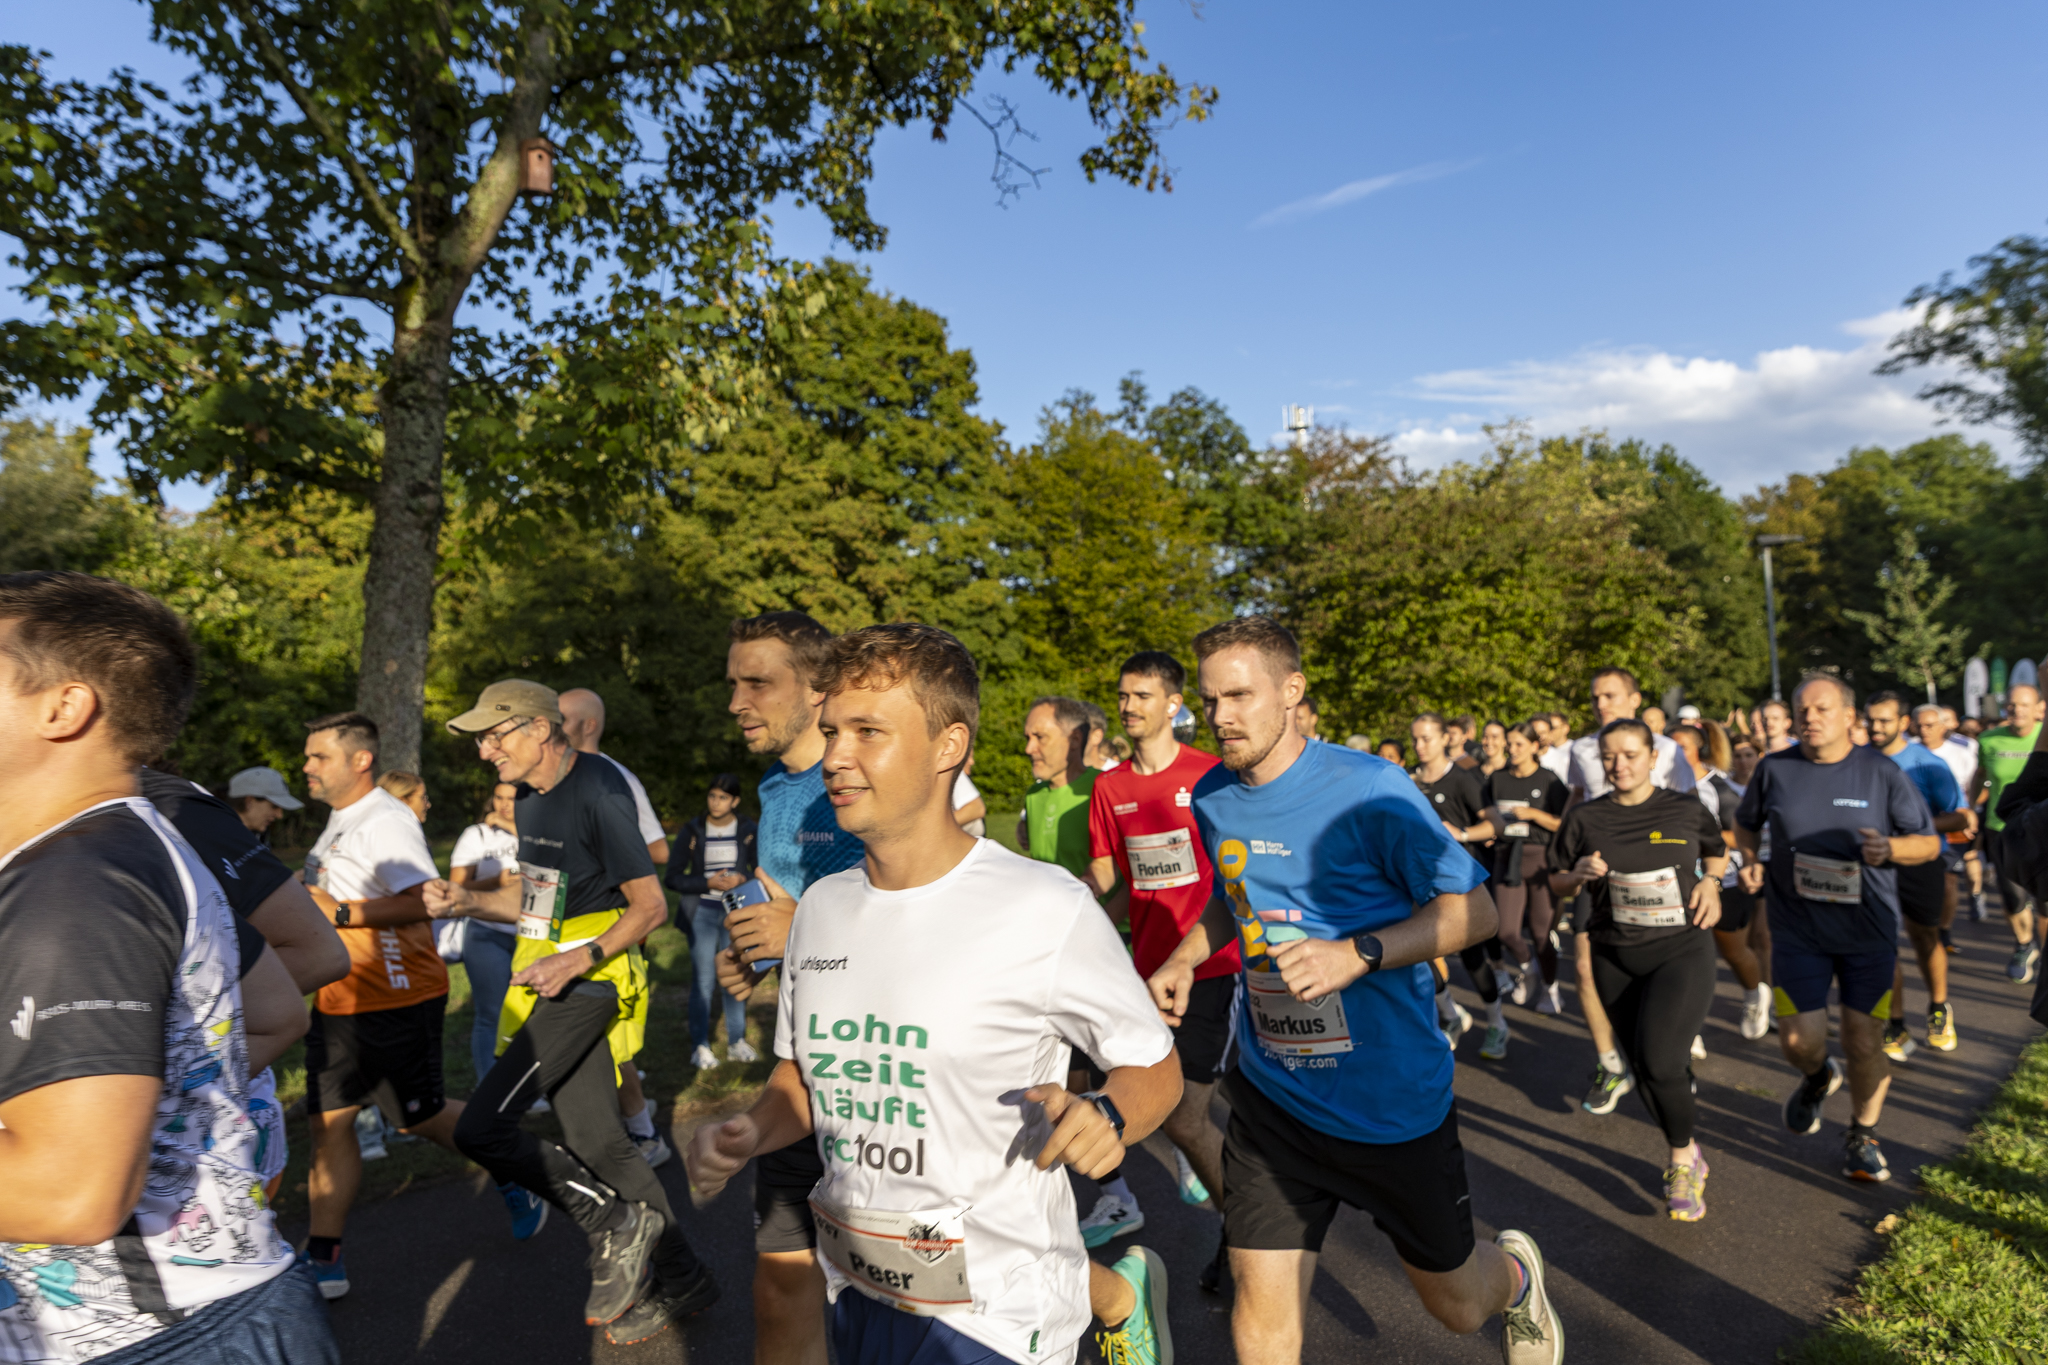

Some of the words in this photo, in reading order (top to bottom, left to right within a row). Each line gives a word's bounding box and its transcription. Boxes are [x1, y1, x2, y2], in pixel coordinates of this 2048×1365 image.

[1137, 862, 1182, 877] Florian
[1801, 878, 1848, 893] Markus
[1623, 895, 1663, 906] Selina
[379, 925, 411, 990] STIHL
[800, 955, 848, 974] uhlsport
[808, 1013, 928, 1050] Lohn
[1257, 1010, 1326, 1036] Markus
[808, 1052, 926, 1089] Zeit
[815, 1087, 926, 1129] Läuft
[823, 1133, 924, 1177] ectool
[848, 1250, 915, 1291] Peer
